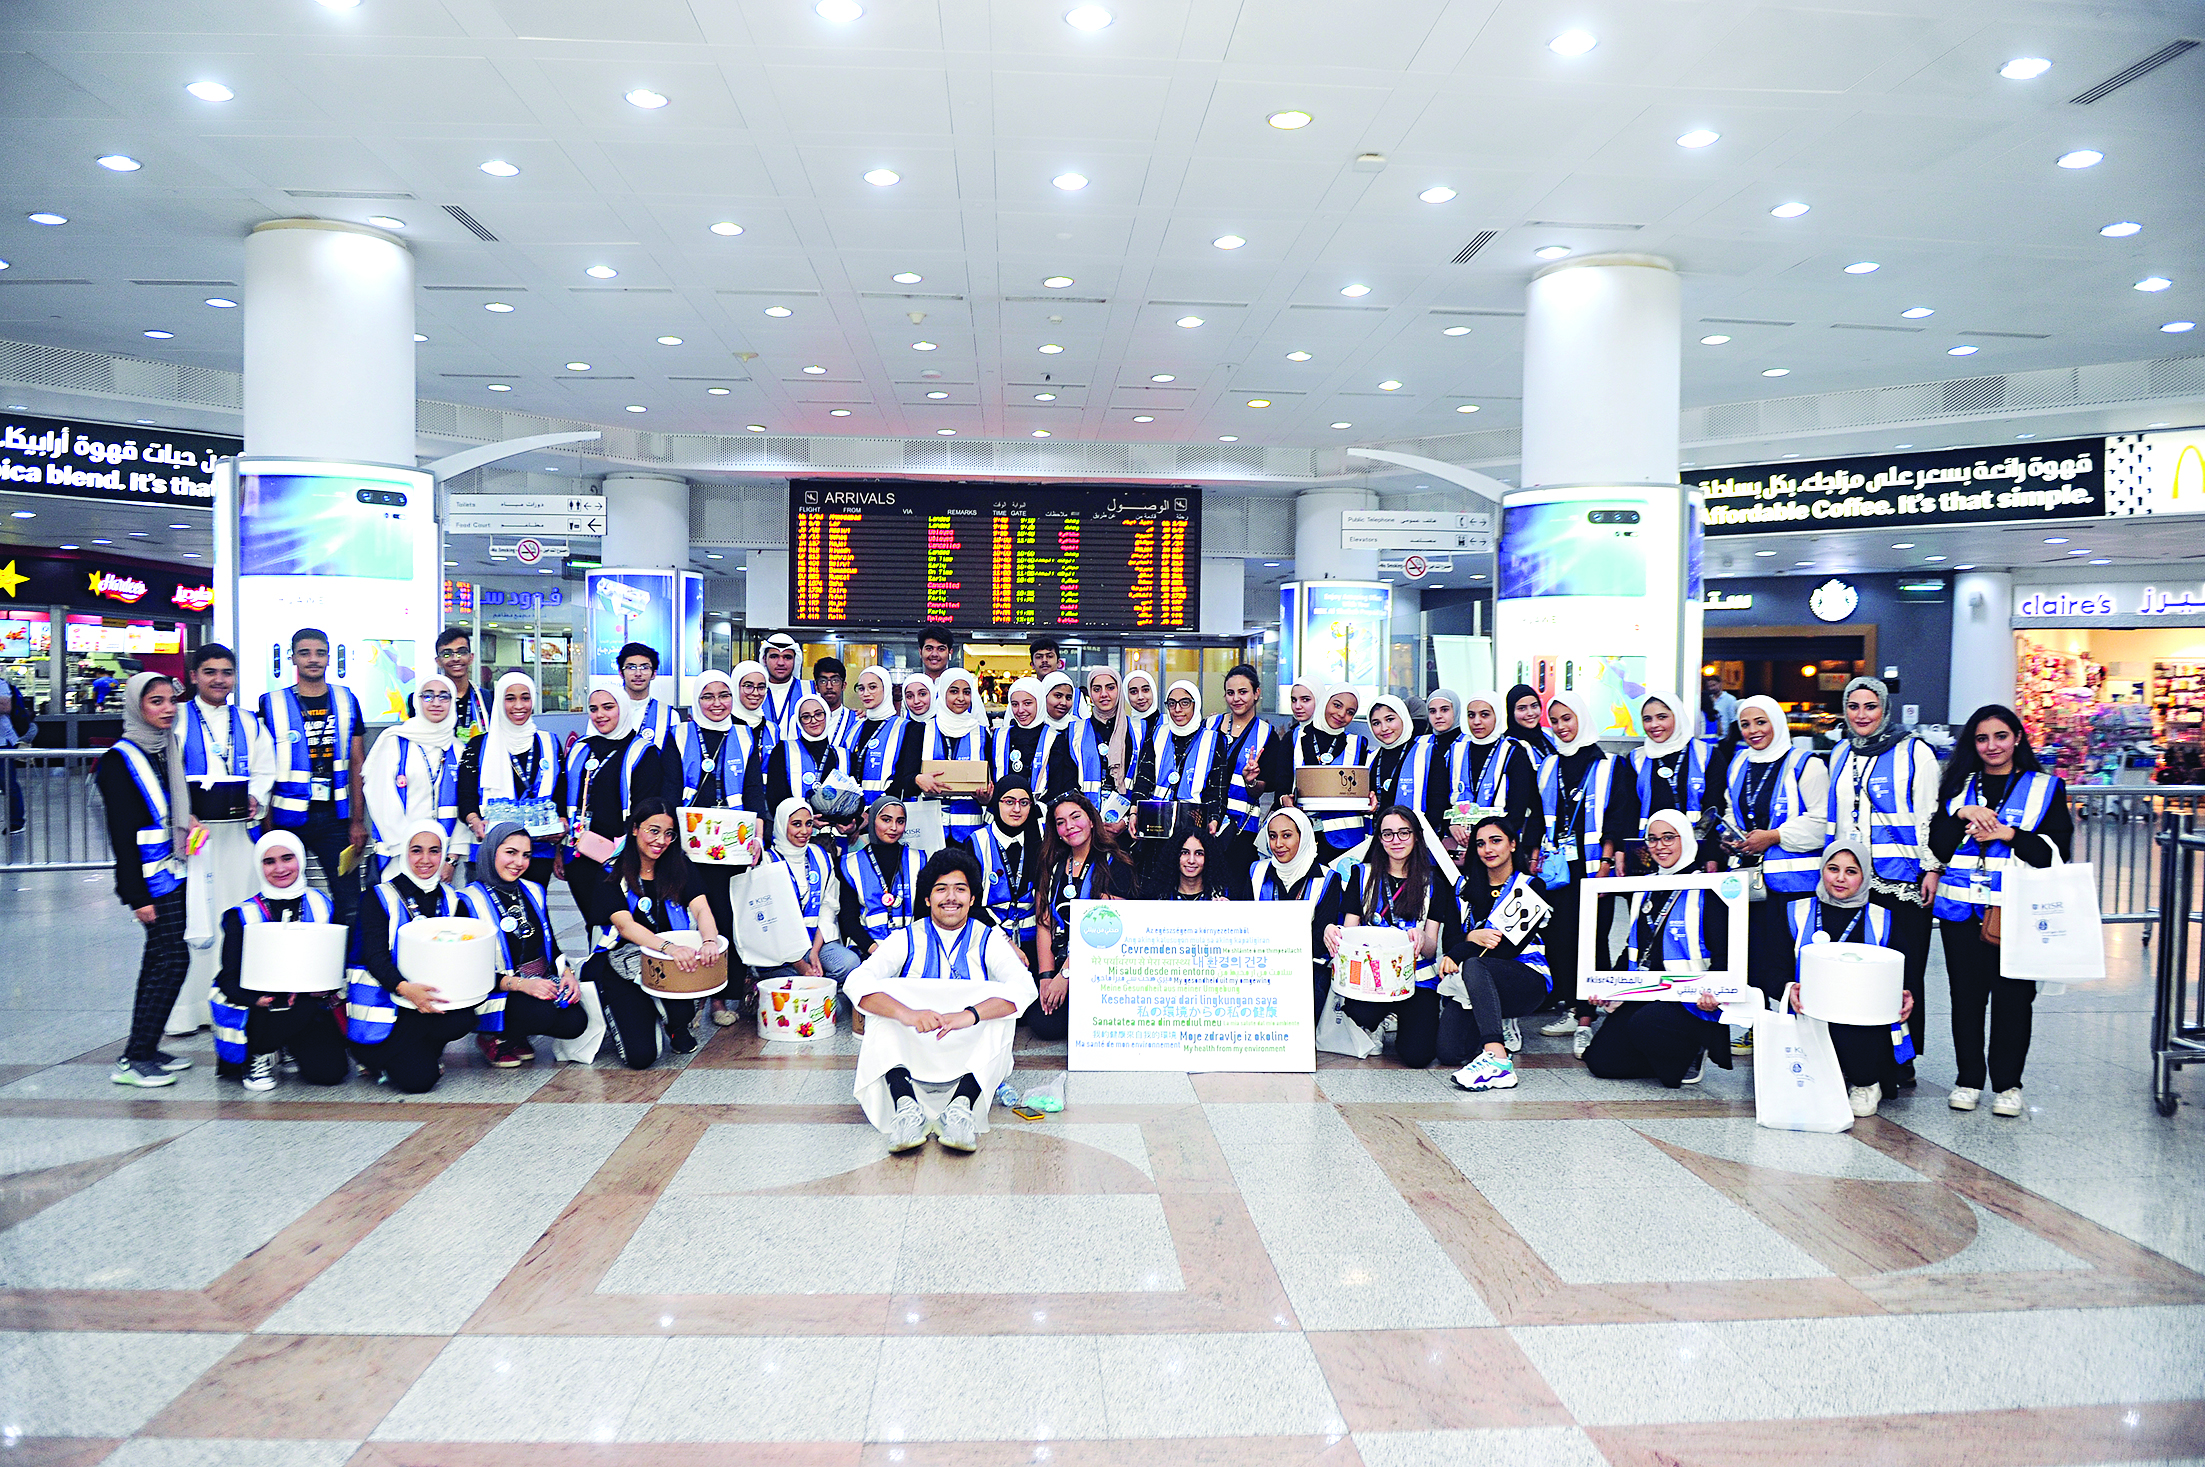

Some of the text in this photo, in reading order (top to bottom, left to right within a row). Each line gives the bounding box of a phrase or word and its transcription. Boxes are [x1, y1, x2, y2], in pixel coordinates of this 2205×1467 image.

[74, 435, 138, 465] قهوة
[142, 442, 197, 469] حبات
[1973, 457, 2026, 483] رائعة
[2028, 453, 2093, 481] قهوة
[46, 463, 126, 490] blend.
[130, 472, 167, 493] It's
[1914, 466, 1972, 490] بسعر
[1762, 474, 1797, 499] بكل
[825, 492, 895, 504] ARRIVALS
[1107, 498, 1169, 513] الوصول
[1700, 483, 2094, 526] Affordable Coffee. It's that simple.
[2022, 594, 2111, 614] claire's
[2140, 588, 2205, 614] يرز
[1122, 944, 1177, 957] Çevremden
[1193, 956, 1268, 968] 내 환경의 건강
[1108, 966, 1215, 976] Mi salud desde mi entorno
[1174, 977, 1182, 985] My
[1123, 984, 1162, 992] Gesundheit
[1203, 985, 1240, 994] Umgebung
[1102, 994, 1277, 1008] Kesehatan saya dari lingkungan saya
[1093, 1017, 1135, 1026] Sanatatea
[1158, 1018, 1170, 1026] din
[1173, 1018, 1202, 1026] mediul
[1180, 1031, 1289, 1044] Moje zdravlje iz okoline
[1184, 1045, 1193, 1054] My
[1233, 1046, 1243, 1054] my
